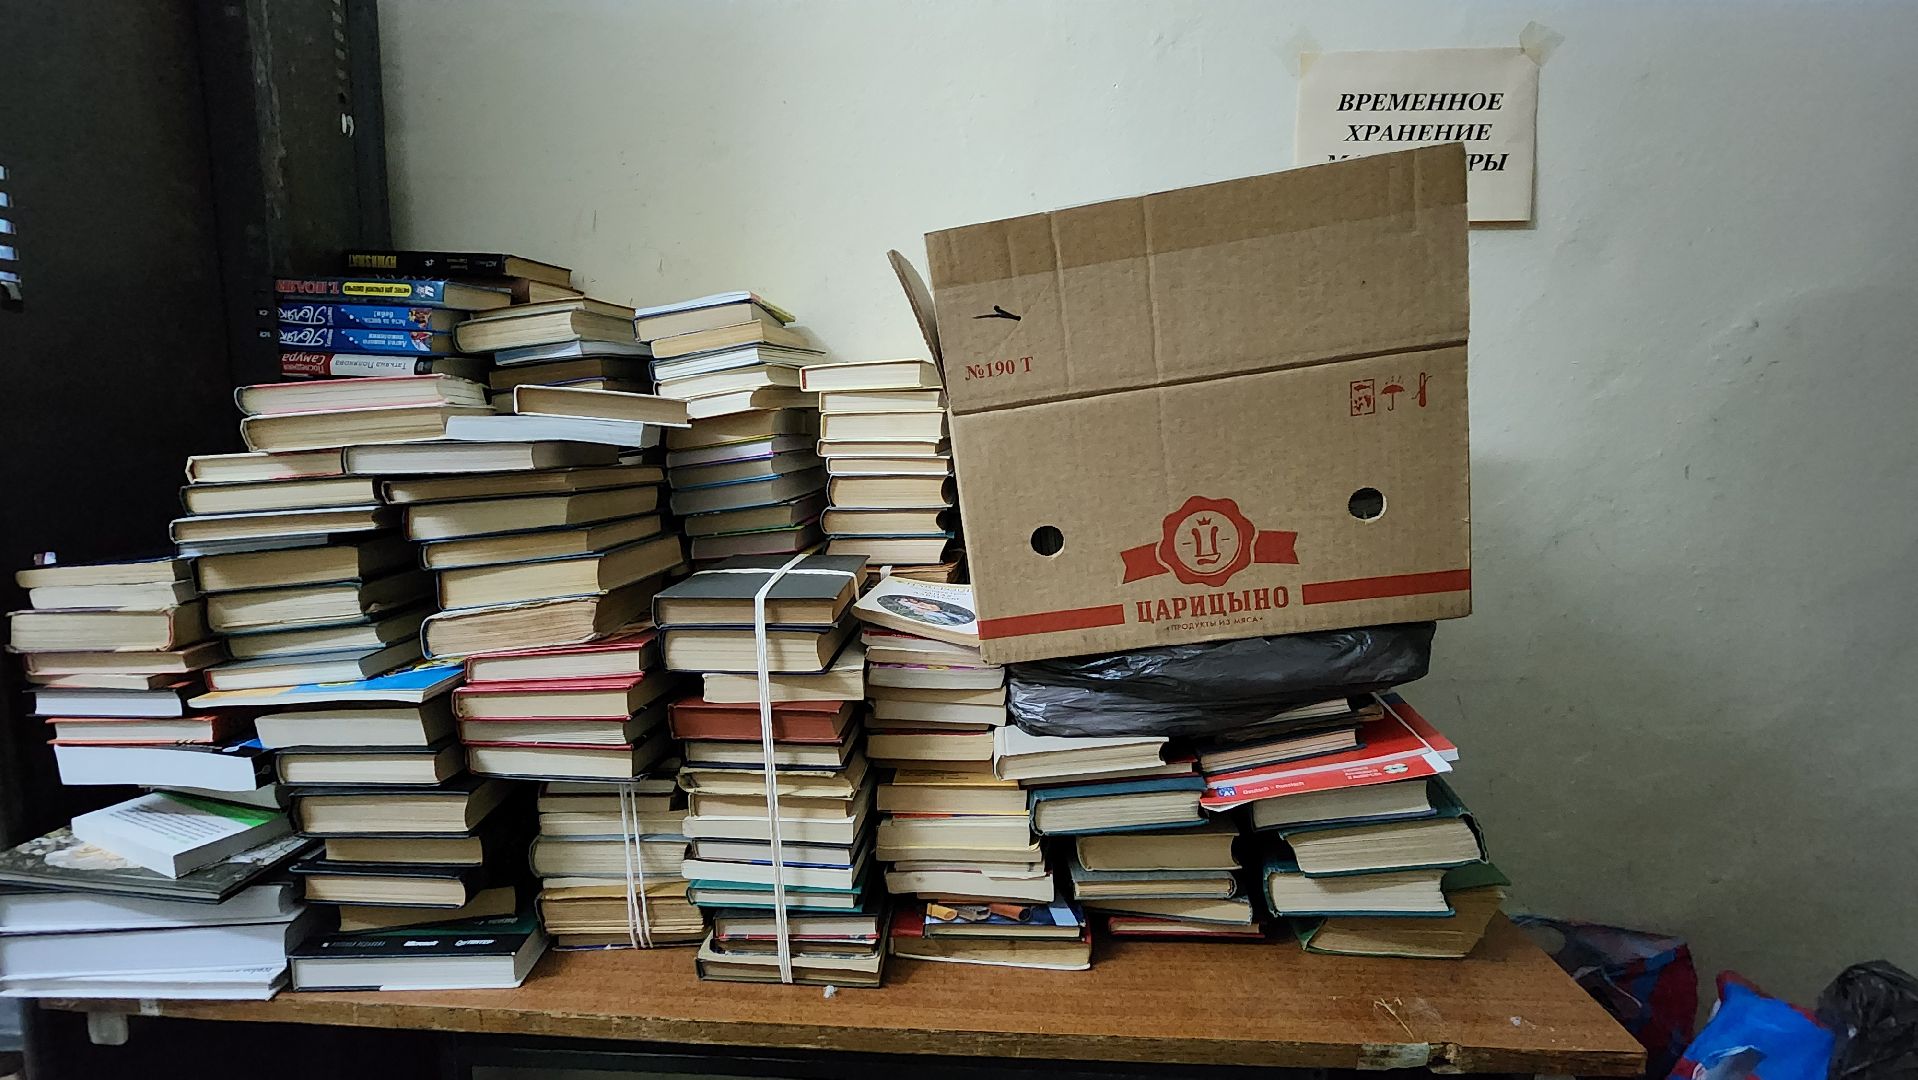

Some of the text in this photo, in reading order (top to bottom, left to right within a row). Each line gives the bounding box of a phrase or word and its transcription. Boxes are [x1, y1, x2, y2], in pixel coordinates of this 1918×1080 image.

[1336, 93, 1505, 111] ВРЕМЕННОЕ
[1343, 124, 1494, 142] ХРАНЕНИЕ
[281, 352, 326, 366] Самура
[335, 360, 407, 370] Татьяна Полякова
[965, 360, 1015, 381] №190
[1136, 585, 1289, 624] ЦАРИЦЫНО
[1219, 619, 1231, 628] ИЗ
